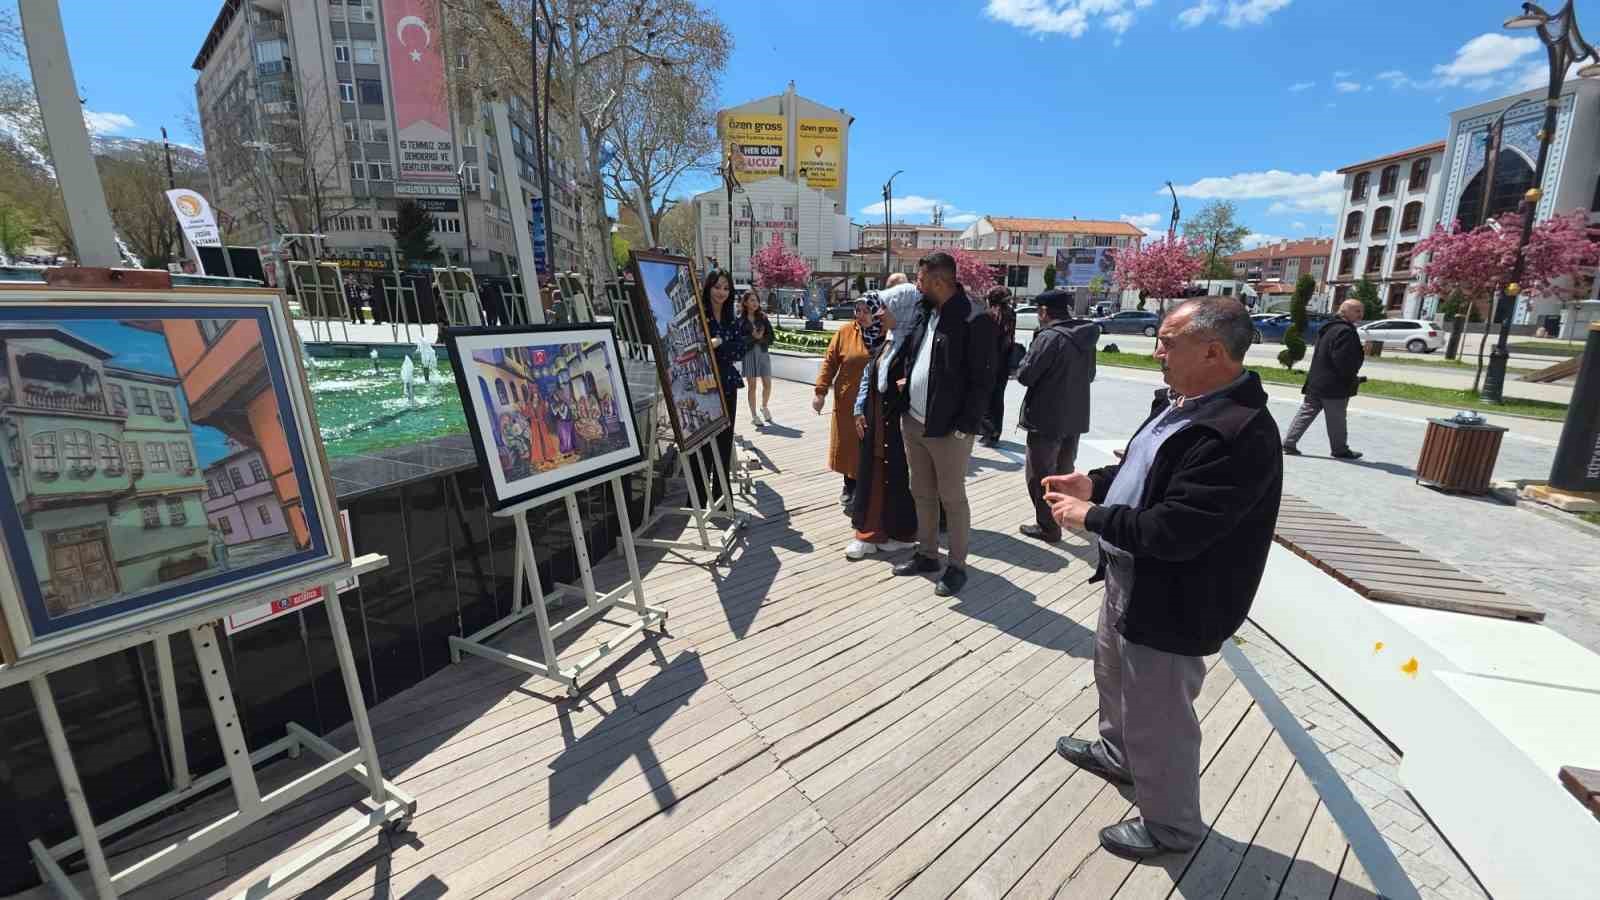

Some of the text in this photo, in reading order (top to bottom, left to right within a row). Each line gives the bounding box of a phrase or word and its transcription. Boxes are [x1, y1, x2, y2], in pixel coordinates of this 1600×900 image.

[754, 121, 783, 133] gross
[761, 145, 780, 155] GÜN
[748, 158, 778, 168] UCUZ
